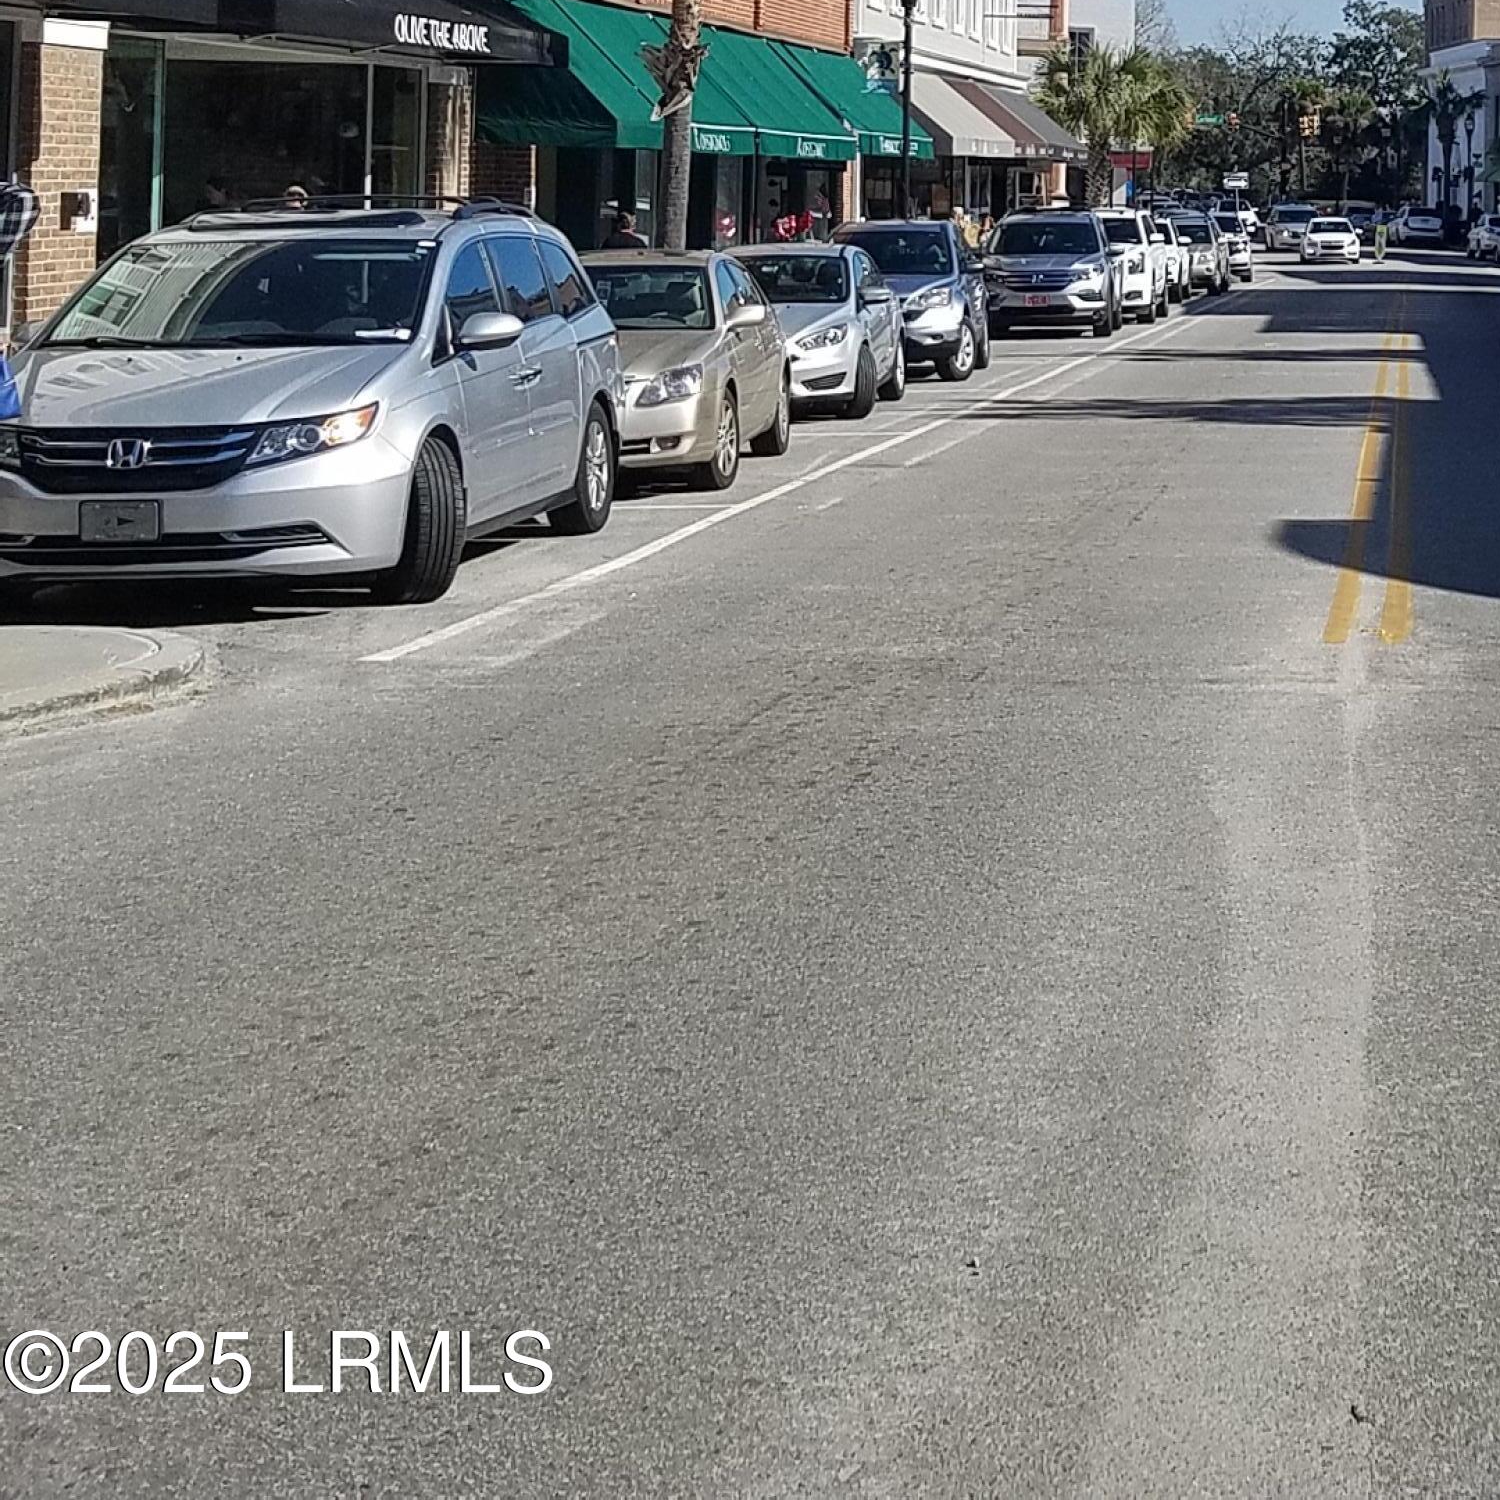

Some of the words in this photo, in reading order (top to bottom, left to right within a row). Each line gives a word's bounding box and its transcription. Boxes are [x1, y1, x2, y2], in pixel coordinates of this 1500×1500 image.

[394, 13, 431, 46] OLIVE
[428, 18, 454, 50] THE
[451, 22, 491, 54] ABOVE
